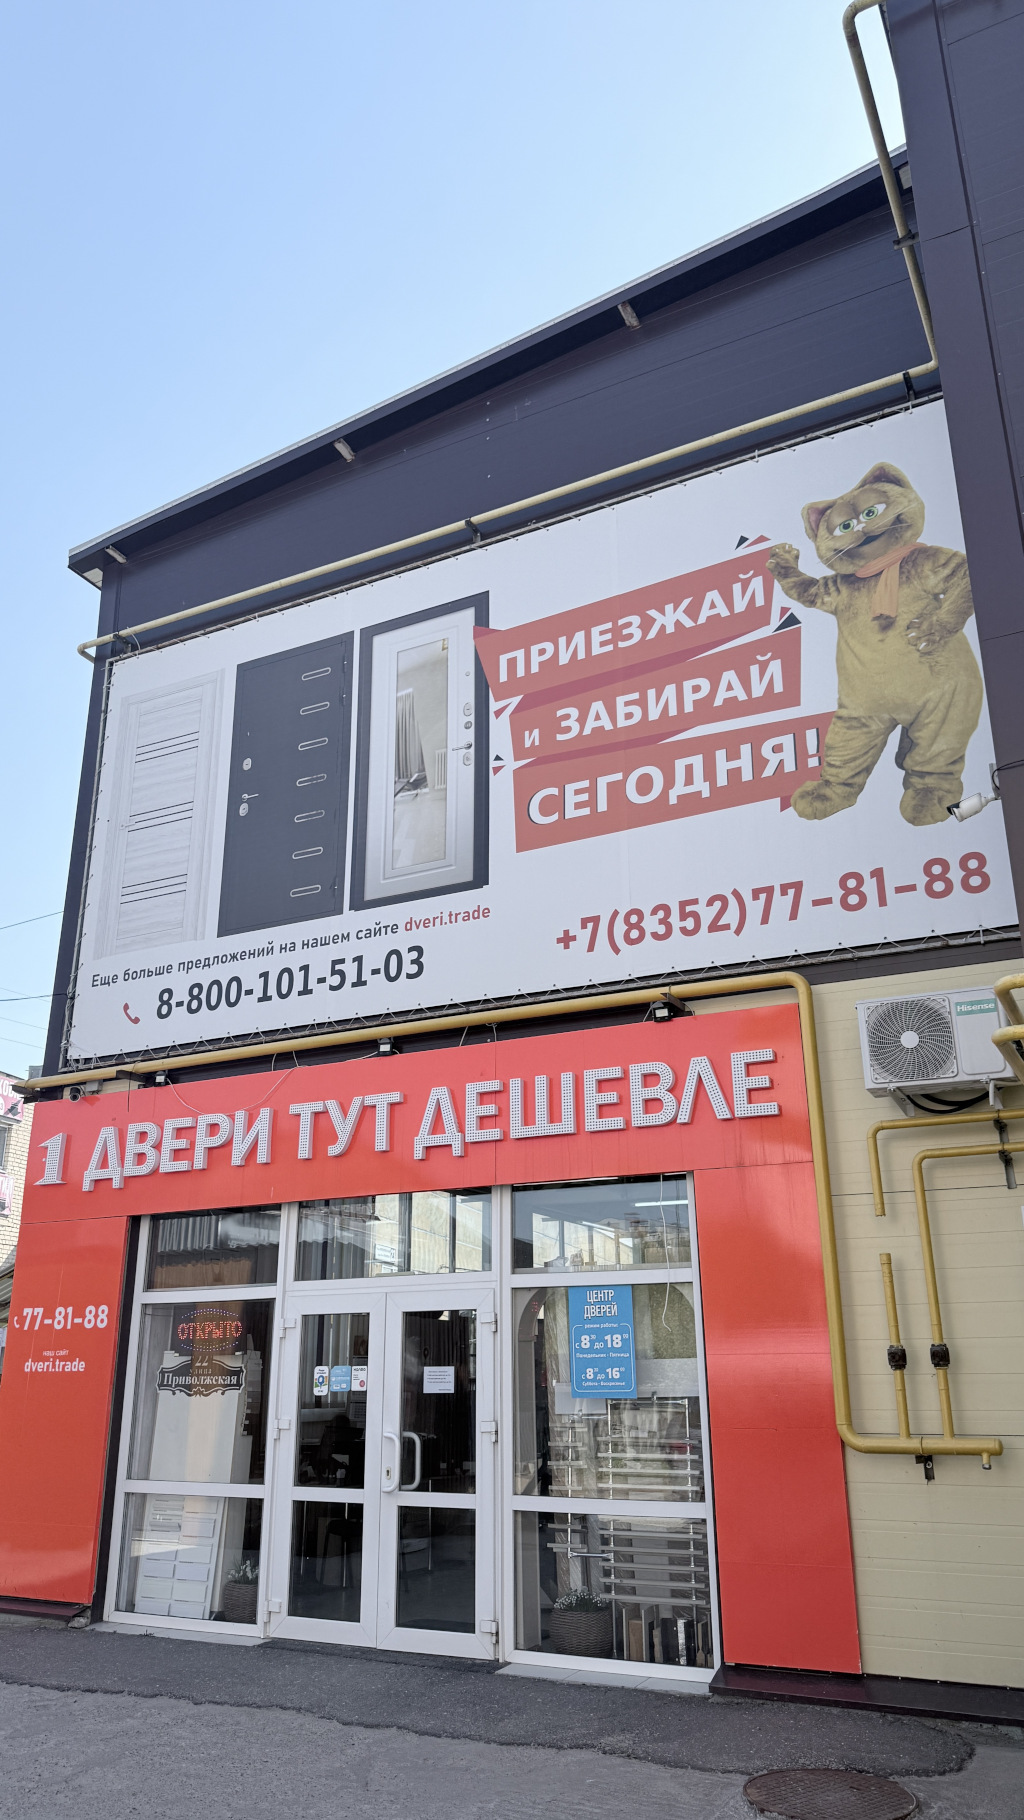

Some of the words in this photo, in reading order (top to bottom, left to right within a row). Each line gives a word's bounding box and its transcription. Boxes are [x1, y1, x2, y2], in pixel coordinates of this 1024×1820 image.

[498, 569, 766, 683] ПРИЕЗЖАЙ
[523, 725, 541, 748] и
[554, 652, 785, 742] ЗАБИРАЙ
[526, 727, 822, 826] СЕГОДНЯ!
[555, 850, 992, 956] +7(8352)77-81-88
[91, 973, 119, 988] Еще
[123, 963, 174, 983] больше
[177, 940, 275, 975] предложений
[279, 941, 296, 955] на
[301, 931, 351, 950] нашем
[355, 921, 399, 940] сайте
[404, 904, 491, 932] dveri.trade
[155, 945, 426, 1021] 8-800-101-51-03
[957, 1002, 995, 1012] Hisense
[33, 1132, 68, 1186] 1
[82, 1107, 274, 1193] ДВЕРИ
[288, 1091, 405, 1160] ТУТ
[413, 1048, 781, 1160] ДЕШЕВЛЕ
[587, 1289, 615, 1304] ЦЕНТР
[22, 1304, 109, 1331] 77-81-88
[584, 1302, 618, 1319] ДВЕРЕЙ
[178, 1321, 243, 1340] ОТКРЫТО
[55, 1348, 70, 1357] сайт
[594, 1341, 604, 1350] до
[24, 1357, 86, 1372] dveri.trade
[163, 1372, 238, 1388] Приволжская
